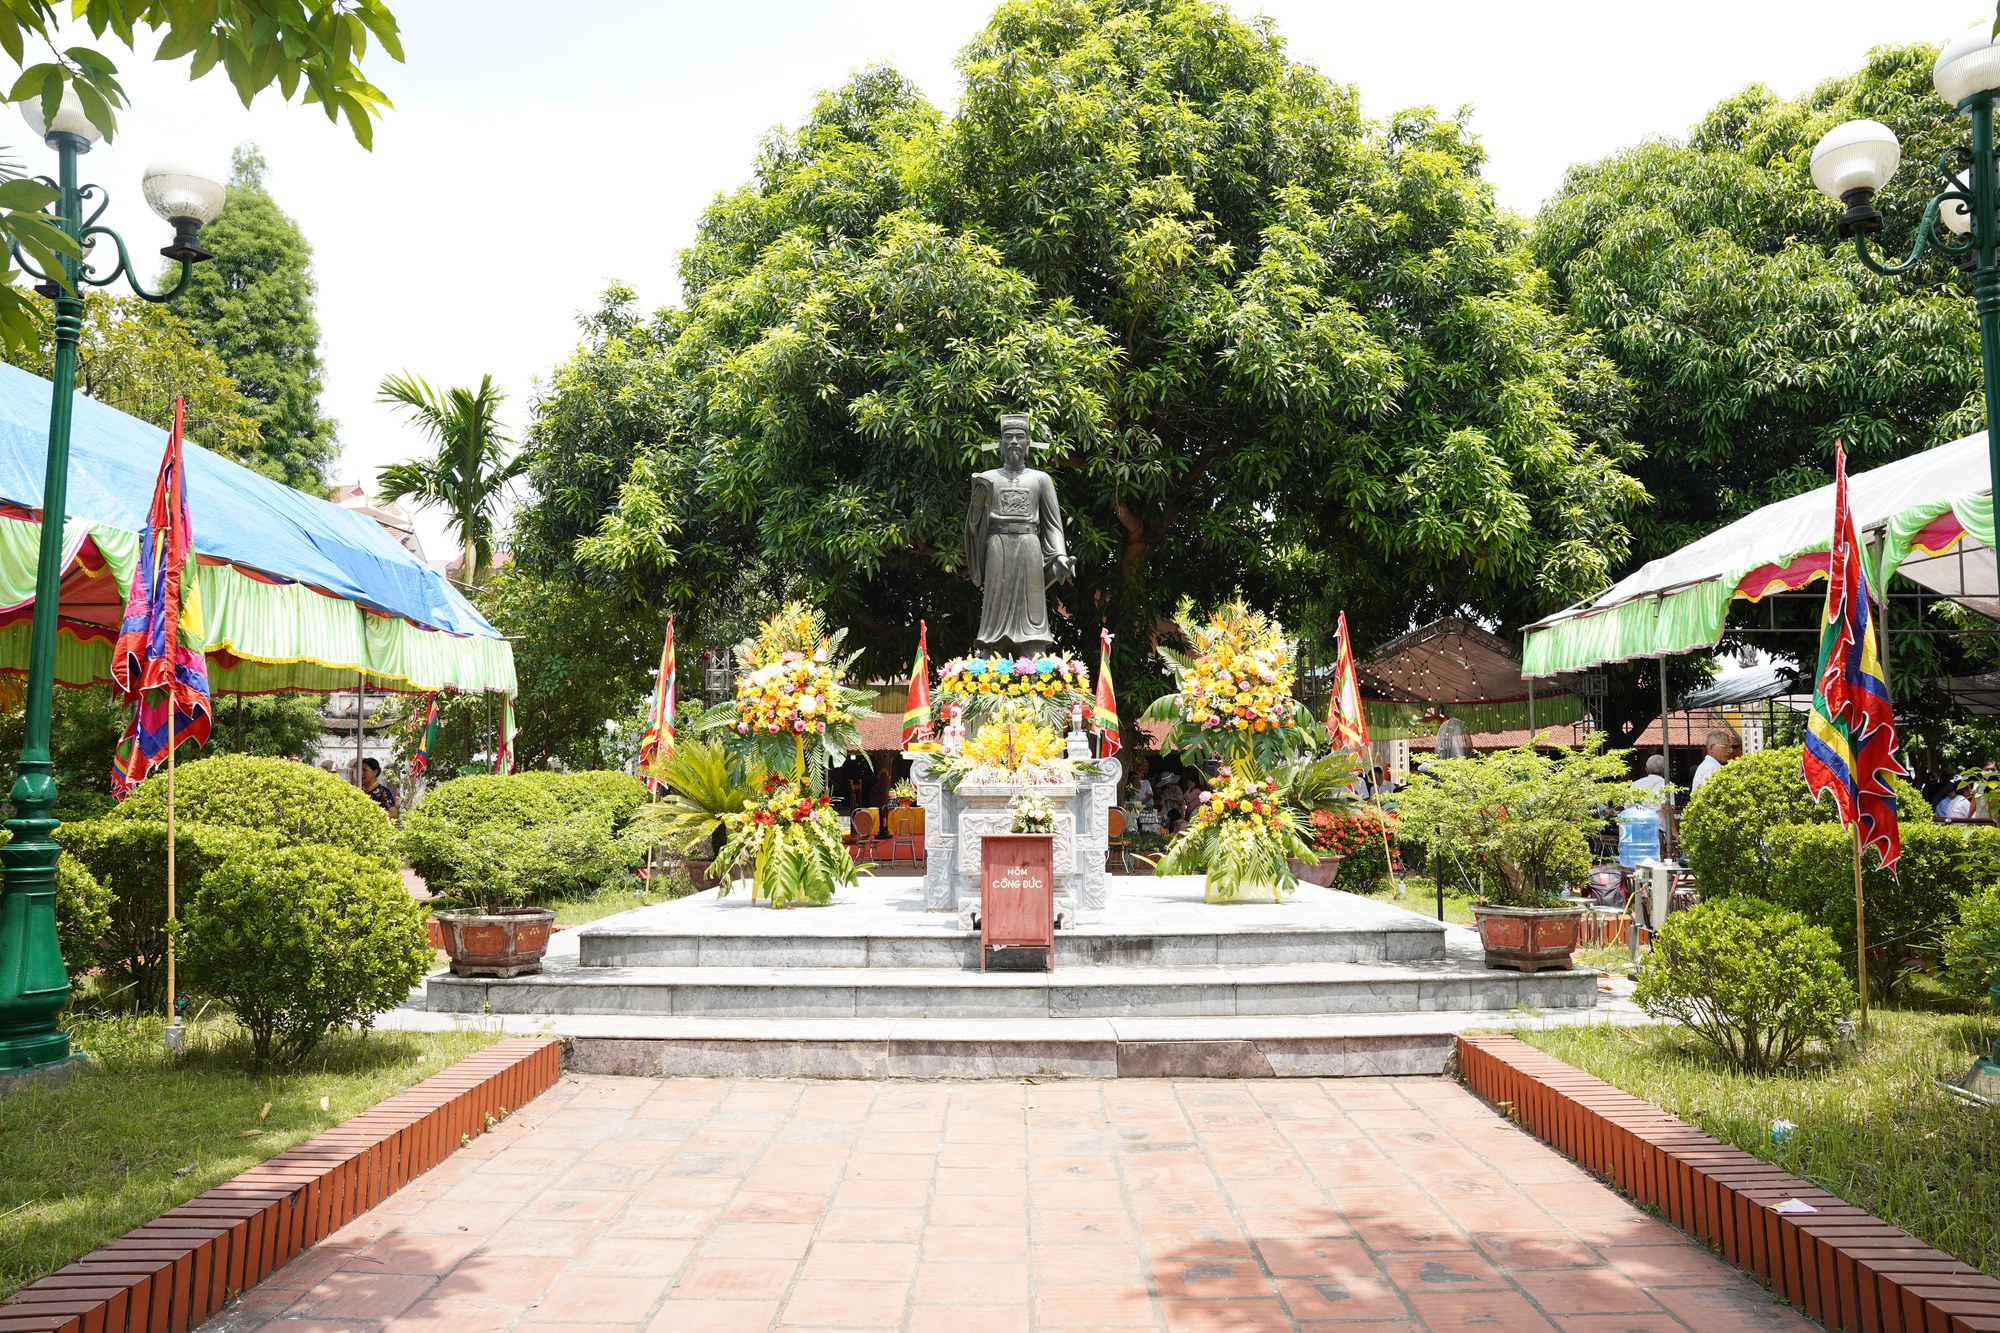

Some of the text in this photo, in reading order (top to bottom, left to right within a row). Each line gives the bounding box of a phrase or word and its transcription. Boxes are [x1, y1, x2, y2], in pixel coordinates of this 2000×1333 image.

[1007, 866, 1028, 876] HÒM
[992, 876, 1043, 889] CÔNG ĐỨC
